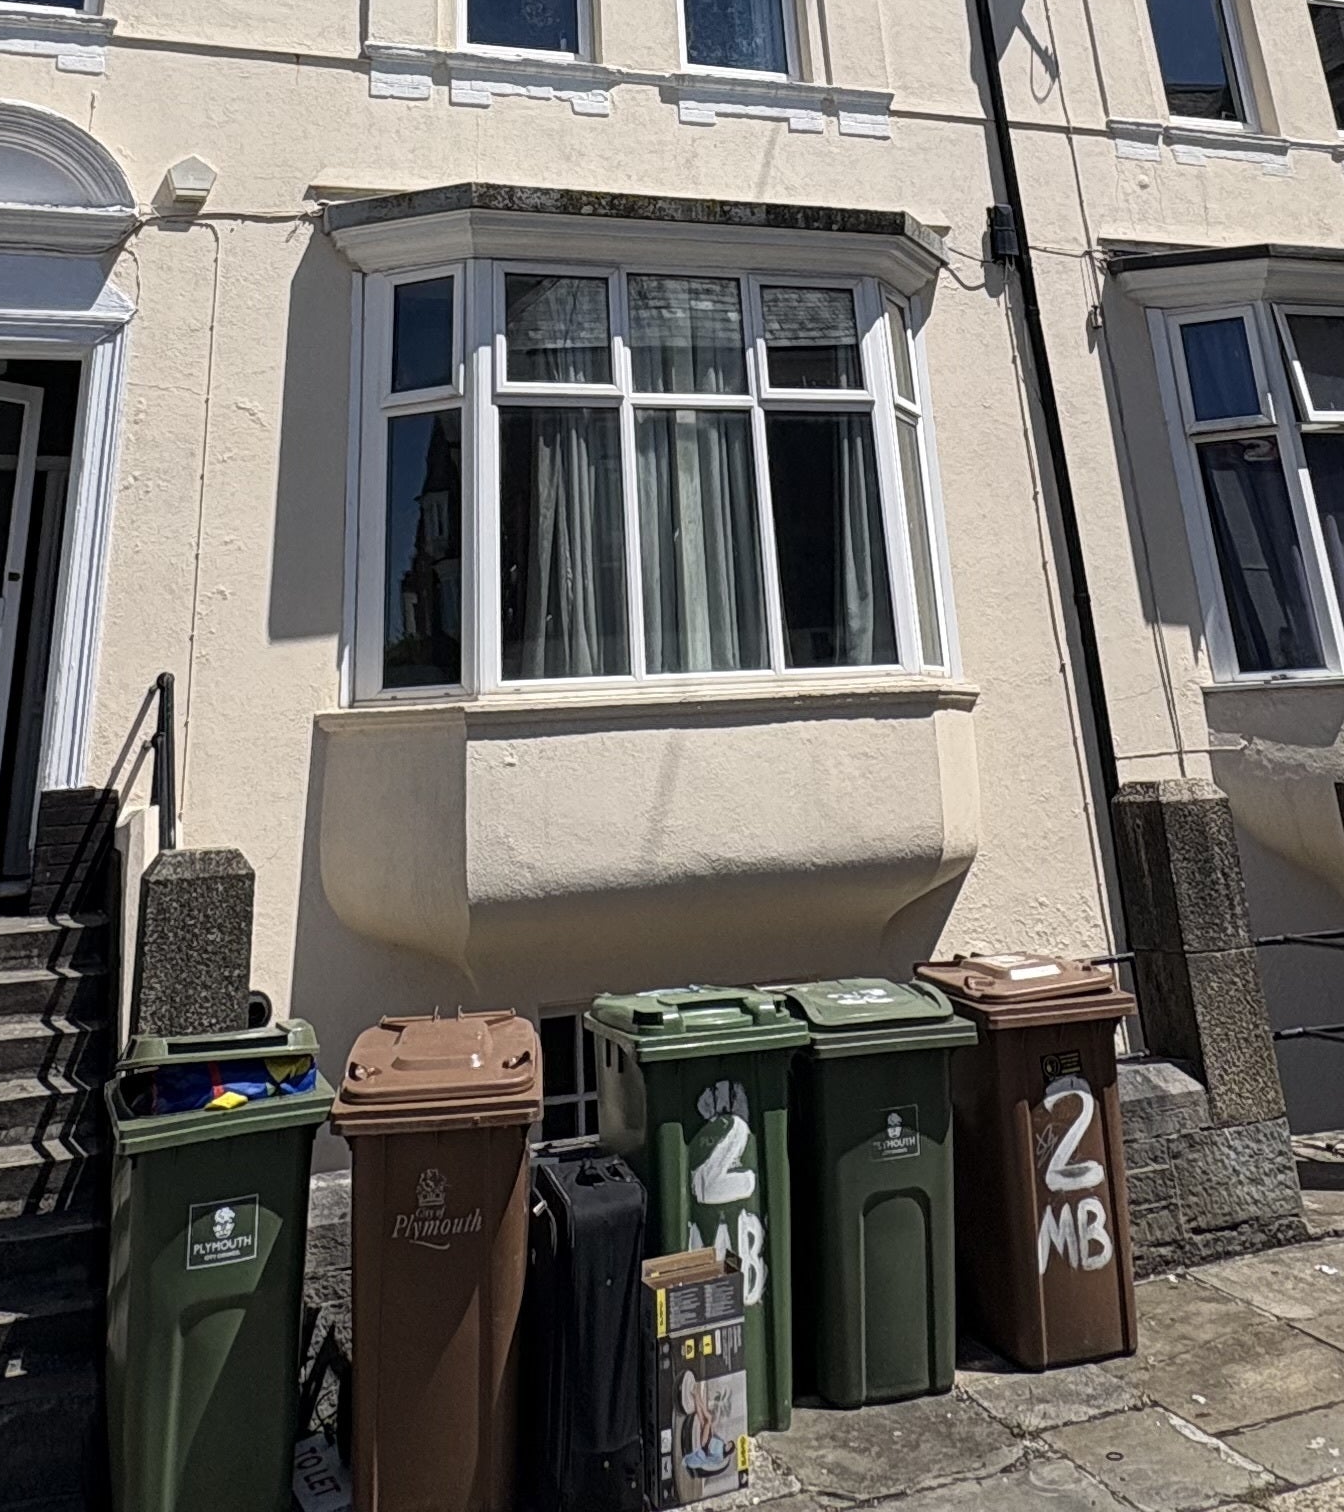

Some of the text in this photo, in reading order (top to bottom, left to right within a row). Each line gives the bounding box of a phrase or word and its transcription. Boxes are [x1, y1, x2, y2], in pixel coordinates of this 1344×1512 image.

[691, 1114, 756, 1204] 2
[1044, 1090, 1105, 1191] 2
[193, 1234, 253, 1256] PLYMOUTH
[392, 1208, 482, 1240] Plymouth
[1038, 1195, 1113, 1275] MB
[294, 1446, 343, 1497] TO LET
